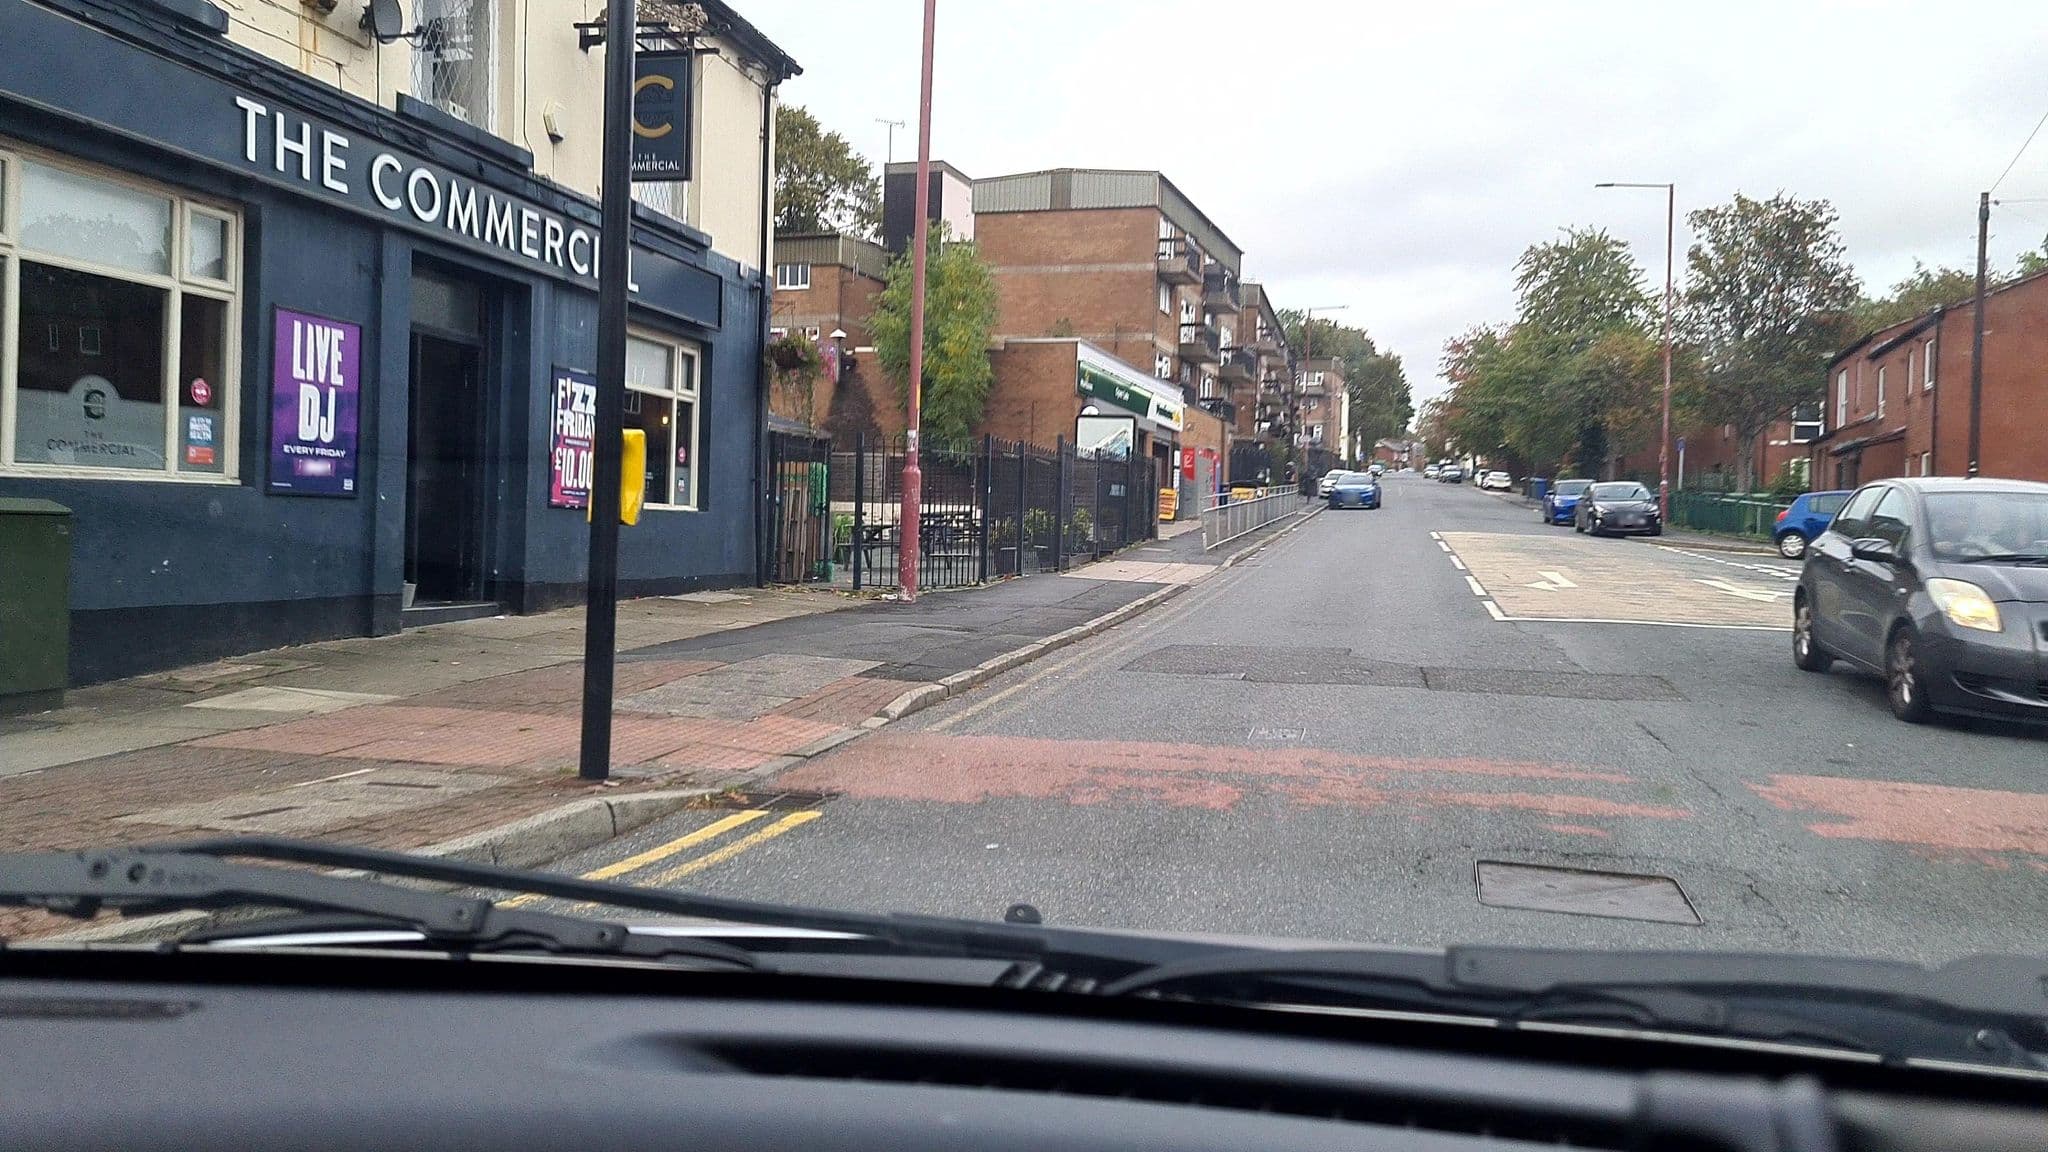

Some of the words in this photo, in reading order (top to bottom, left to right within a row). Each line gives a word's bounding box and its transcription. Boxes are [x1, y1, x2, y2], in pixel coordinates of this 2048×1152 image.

[630, 160, 680, 172] MMERCIAL
[235, 95, 349, 194] THE
[371, 153, 639, 293] COMMERCIL
[292, 319, 345, 387] LIVE
[298, 382, 337, 443] DJ
[283, 444, 314, 456] EVERY
[315, 447, 346, 458] FRIDAY
[554, 446, 594, 490] £10.00
